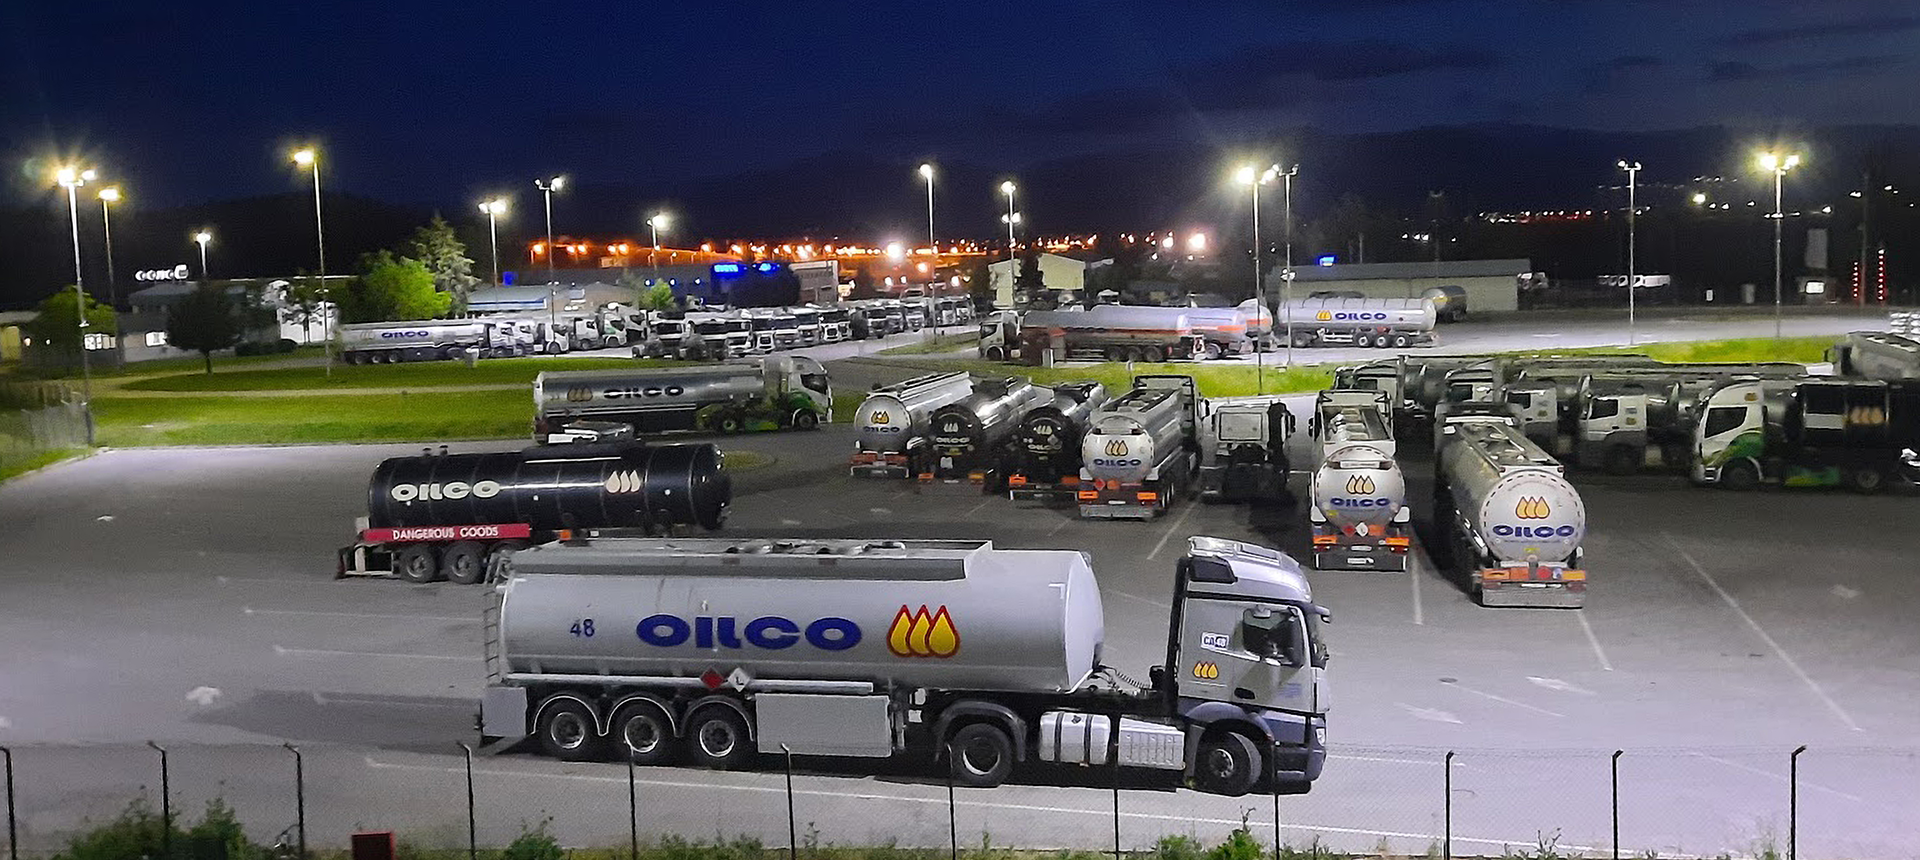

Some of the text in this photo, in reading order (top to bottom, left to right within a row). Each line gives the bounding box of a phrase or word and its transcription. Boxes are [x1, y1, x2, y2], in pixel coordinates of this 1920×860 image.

[391, 480, 500, 502] OILCO
[1330, 498, 1390, 507] OILCO
[392, 526, 499, 540] DANGEROUS GOODS
[1492, 525, 1575, 538] OILCO
[569, 618, 595, 638] 48
[636, 614, 862, 651] OILCO
